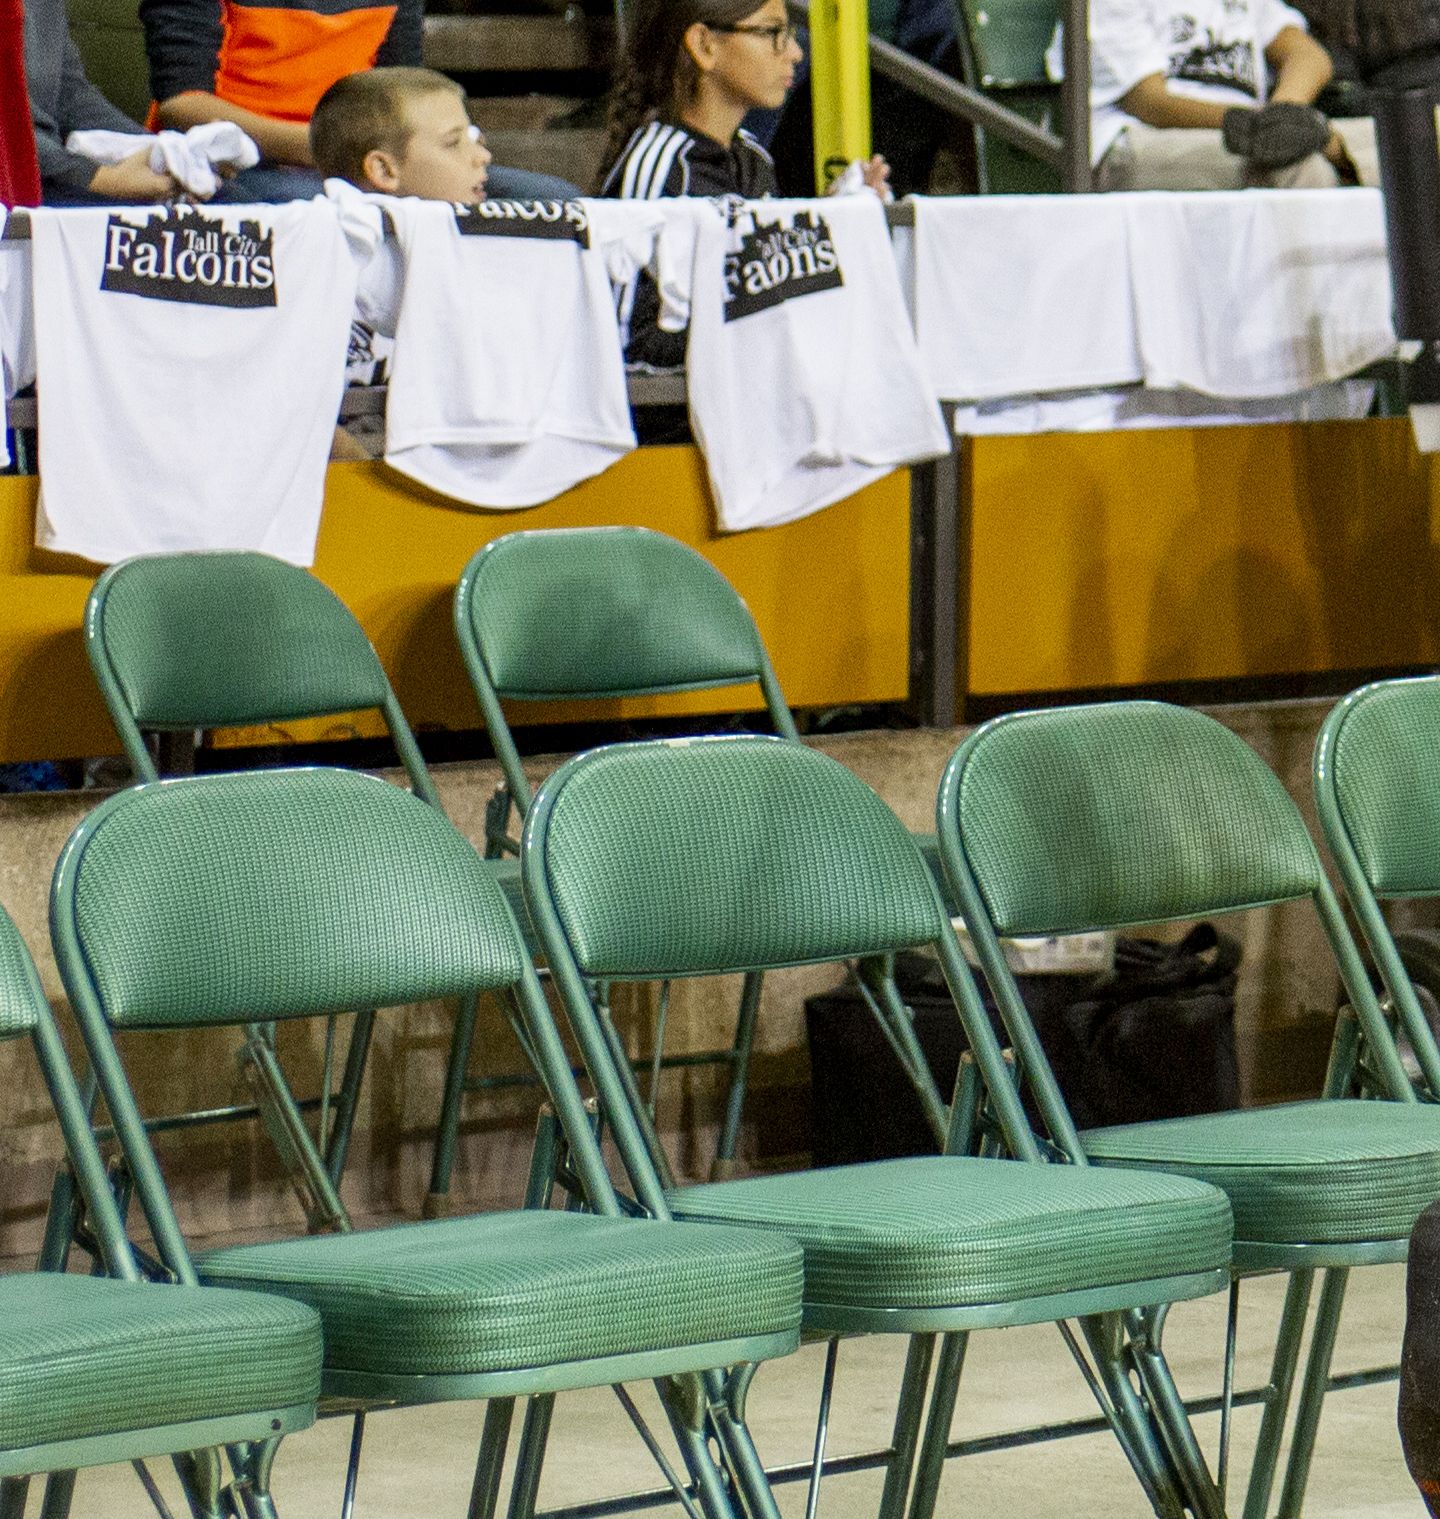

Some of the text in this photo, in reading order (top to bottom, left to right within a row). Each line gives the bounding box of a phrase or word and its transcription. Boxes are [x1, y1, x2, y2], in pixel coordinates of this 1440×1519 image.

[105, 224, 274, 290] Falcons
[183, 228, 260, 257] Tall City
